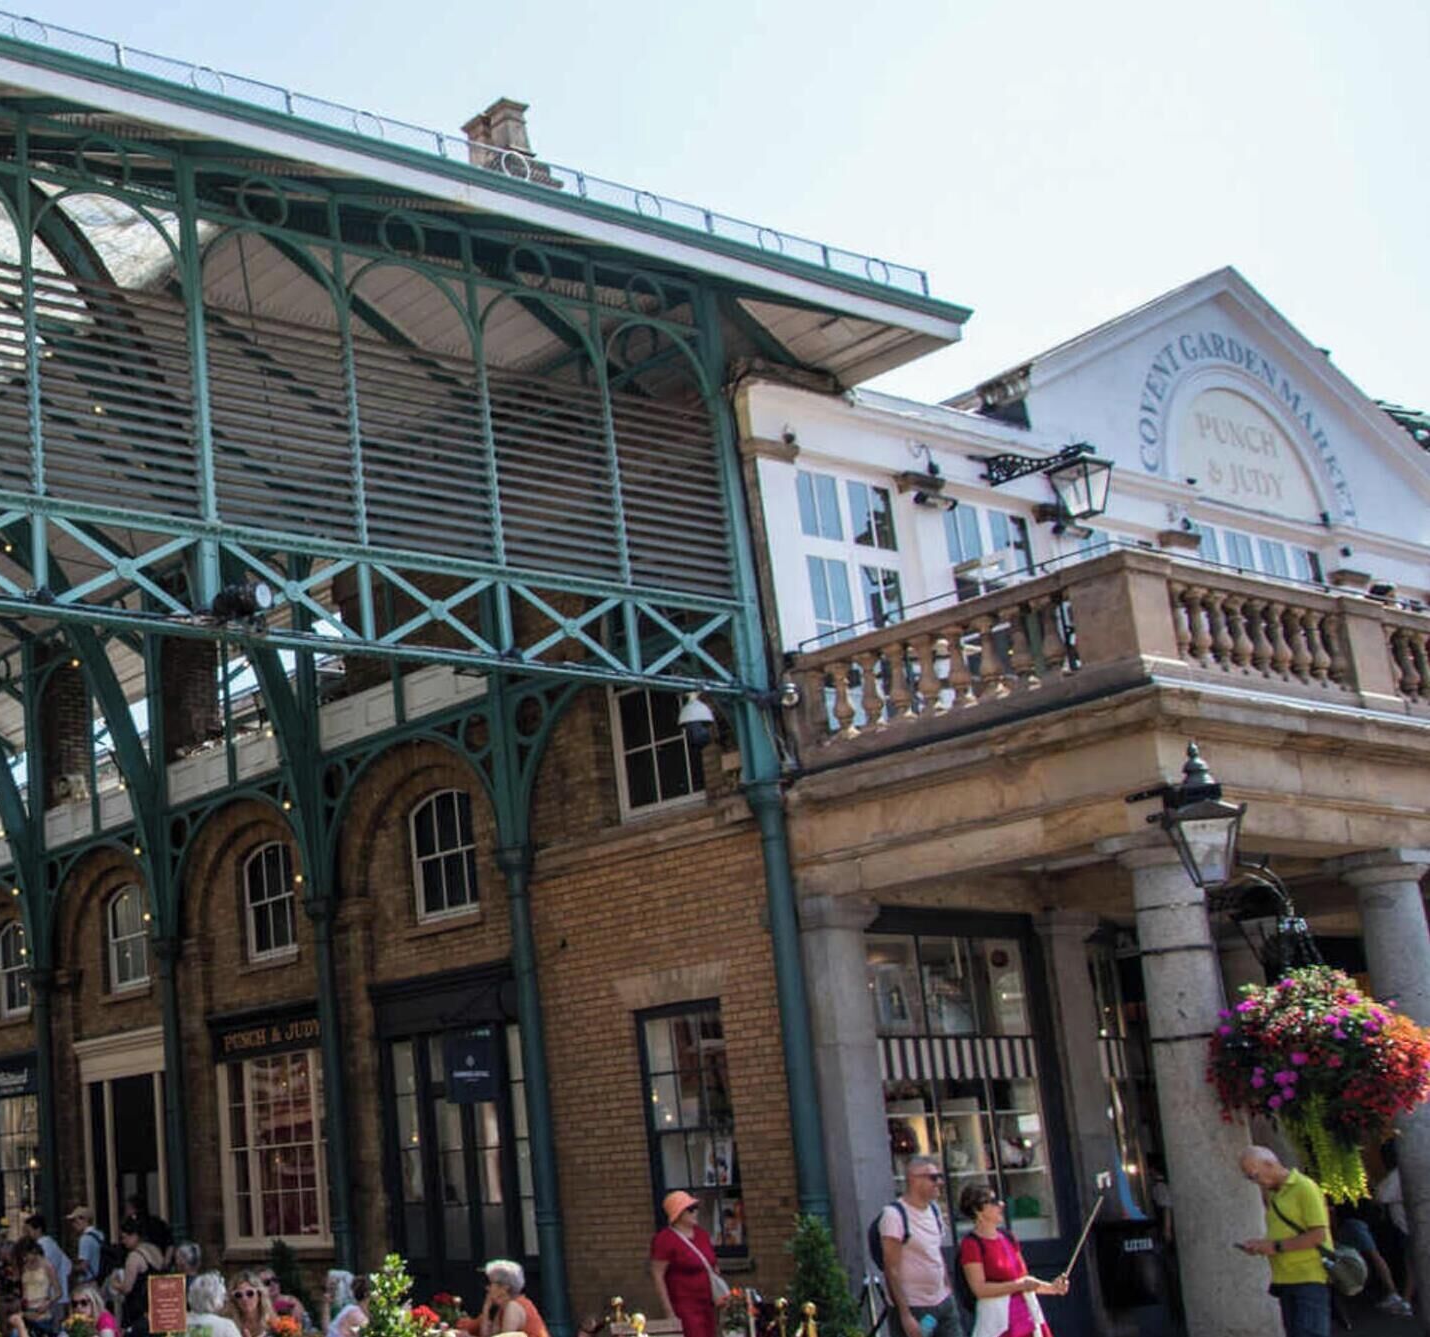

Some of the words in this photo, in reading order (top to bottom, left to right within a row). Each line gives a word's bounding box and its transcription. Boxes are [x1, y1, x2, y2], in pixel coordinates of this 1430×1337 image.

[1138, 343, 1180, 473] COVENT
[1178, 331, 1277, 388] GARDEN
[1280, 379, 1357, 523] MARKET
[1196, 412, 1278, 458] PUNCH
[1208, 458, 1223, 484] &
[1229, 462, 1284, 499] JUDY
[223, 1028, 266, 1053] PUNCH
